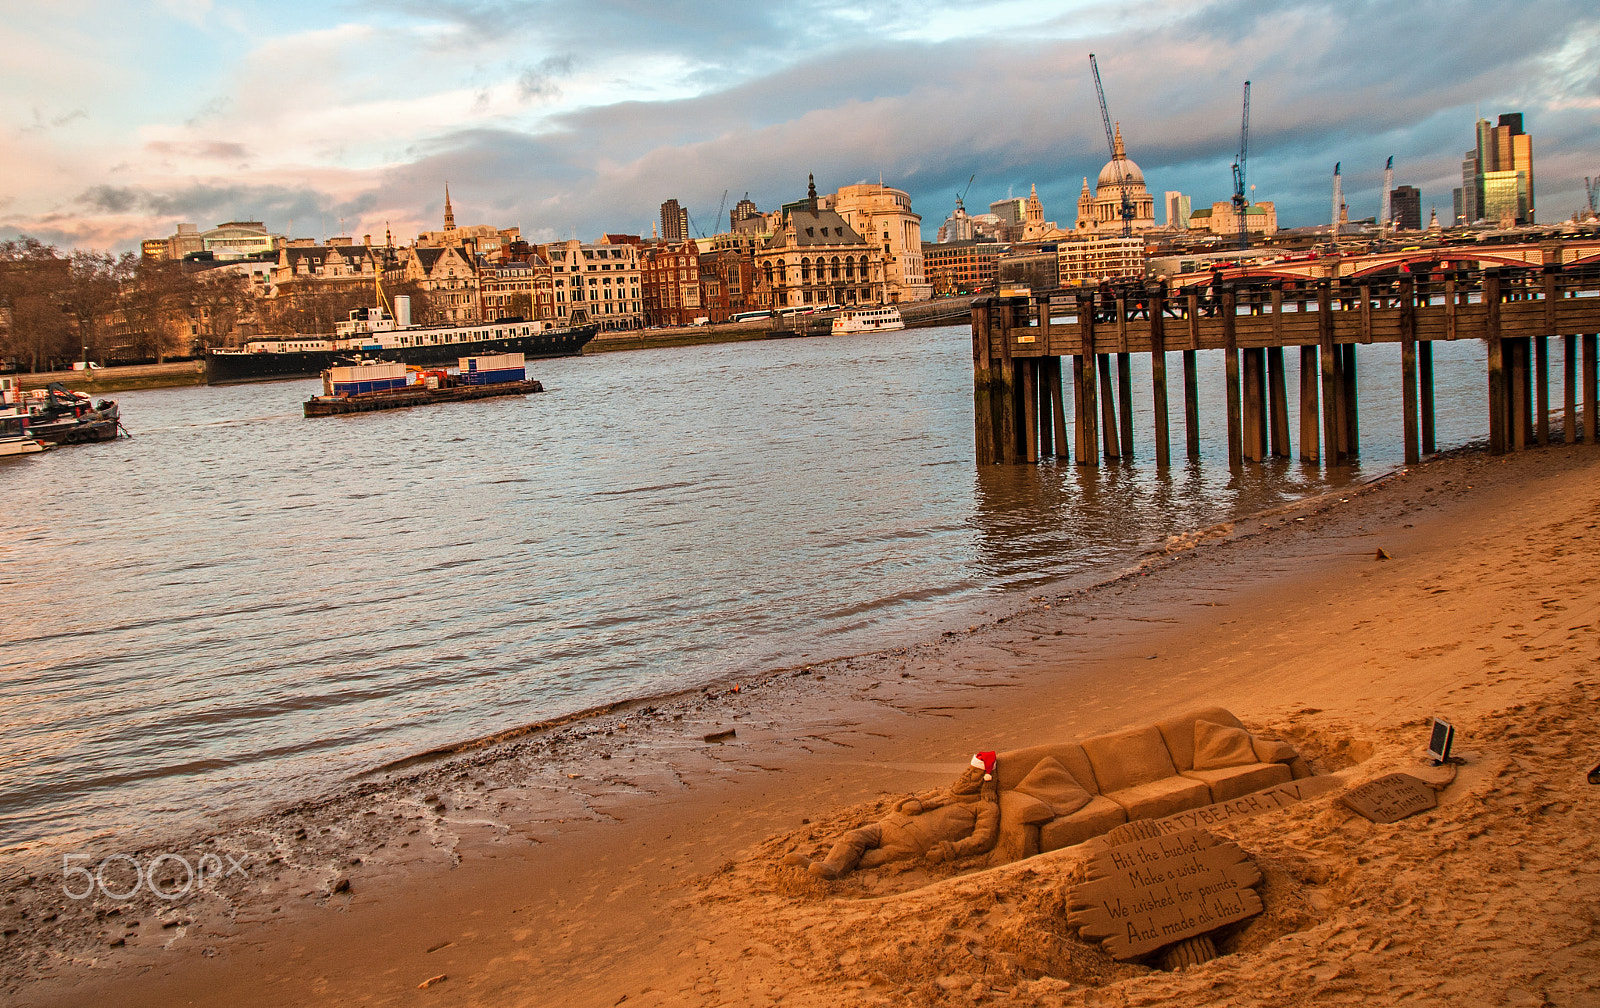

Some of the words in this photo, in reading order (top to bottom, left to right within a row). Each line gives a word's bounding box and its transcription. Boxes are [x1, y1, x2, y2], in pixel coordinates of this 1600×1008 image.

[1110, 852, 1136, 871] Hit
[1136, 846, 1160, 864] the
[1159, 836, 1207, 859] bucket,
[1128, 867, 1166, 889] Make
[1167, 869, 1176, 880] a
[1176, 856, 1211, 878] wish,
[1103, 898, 1130, 920] We
[1133, 887, 1176, 914] wished
[1176, 883, 1194, 902] for
[1198, 870, 1239, 905] pounds
[1126, 917, 1160, 945] And
[1161, 908, 1197, 937] made
[1198, 901, 1215, 925] all
[1215, 891, 1247, 919] this!
